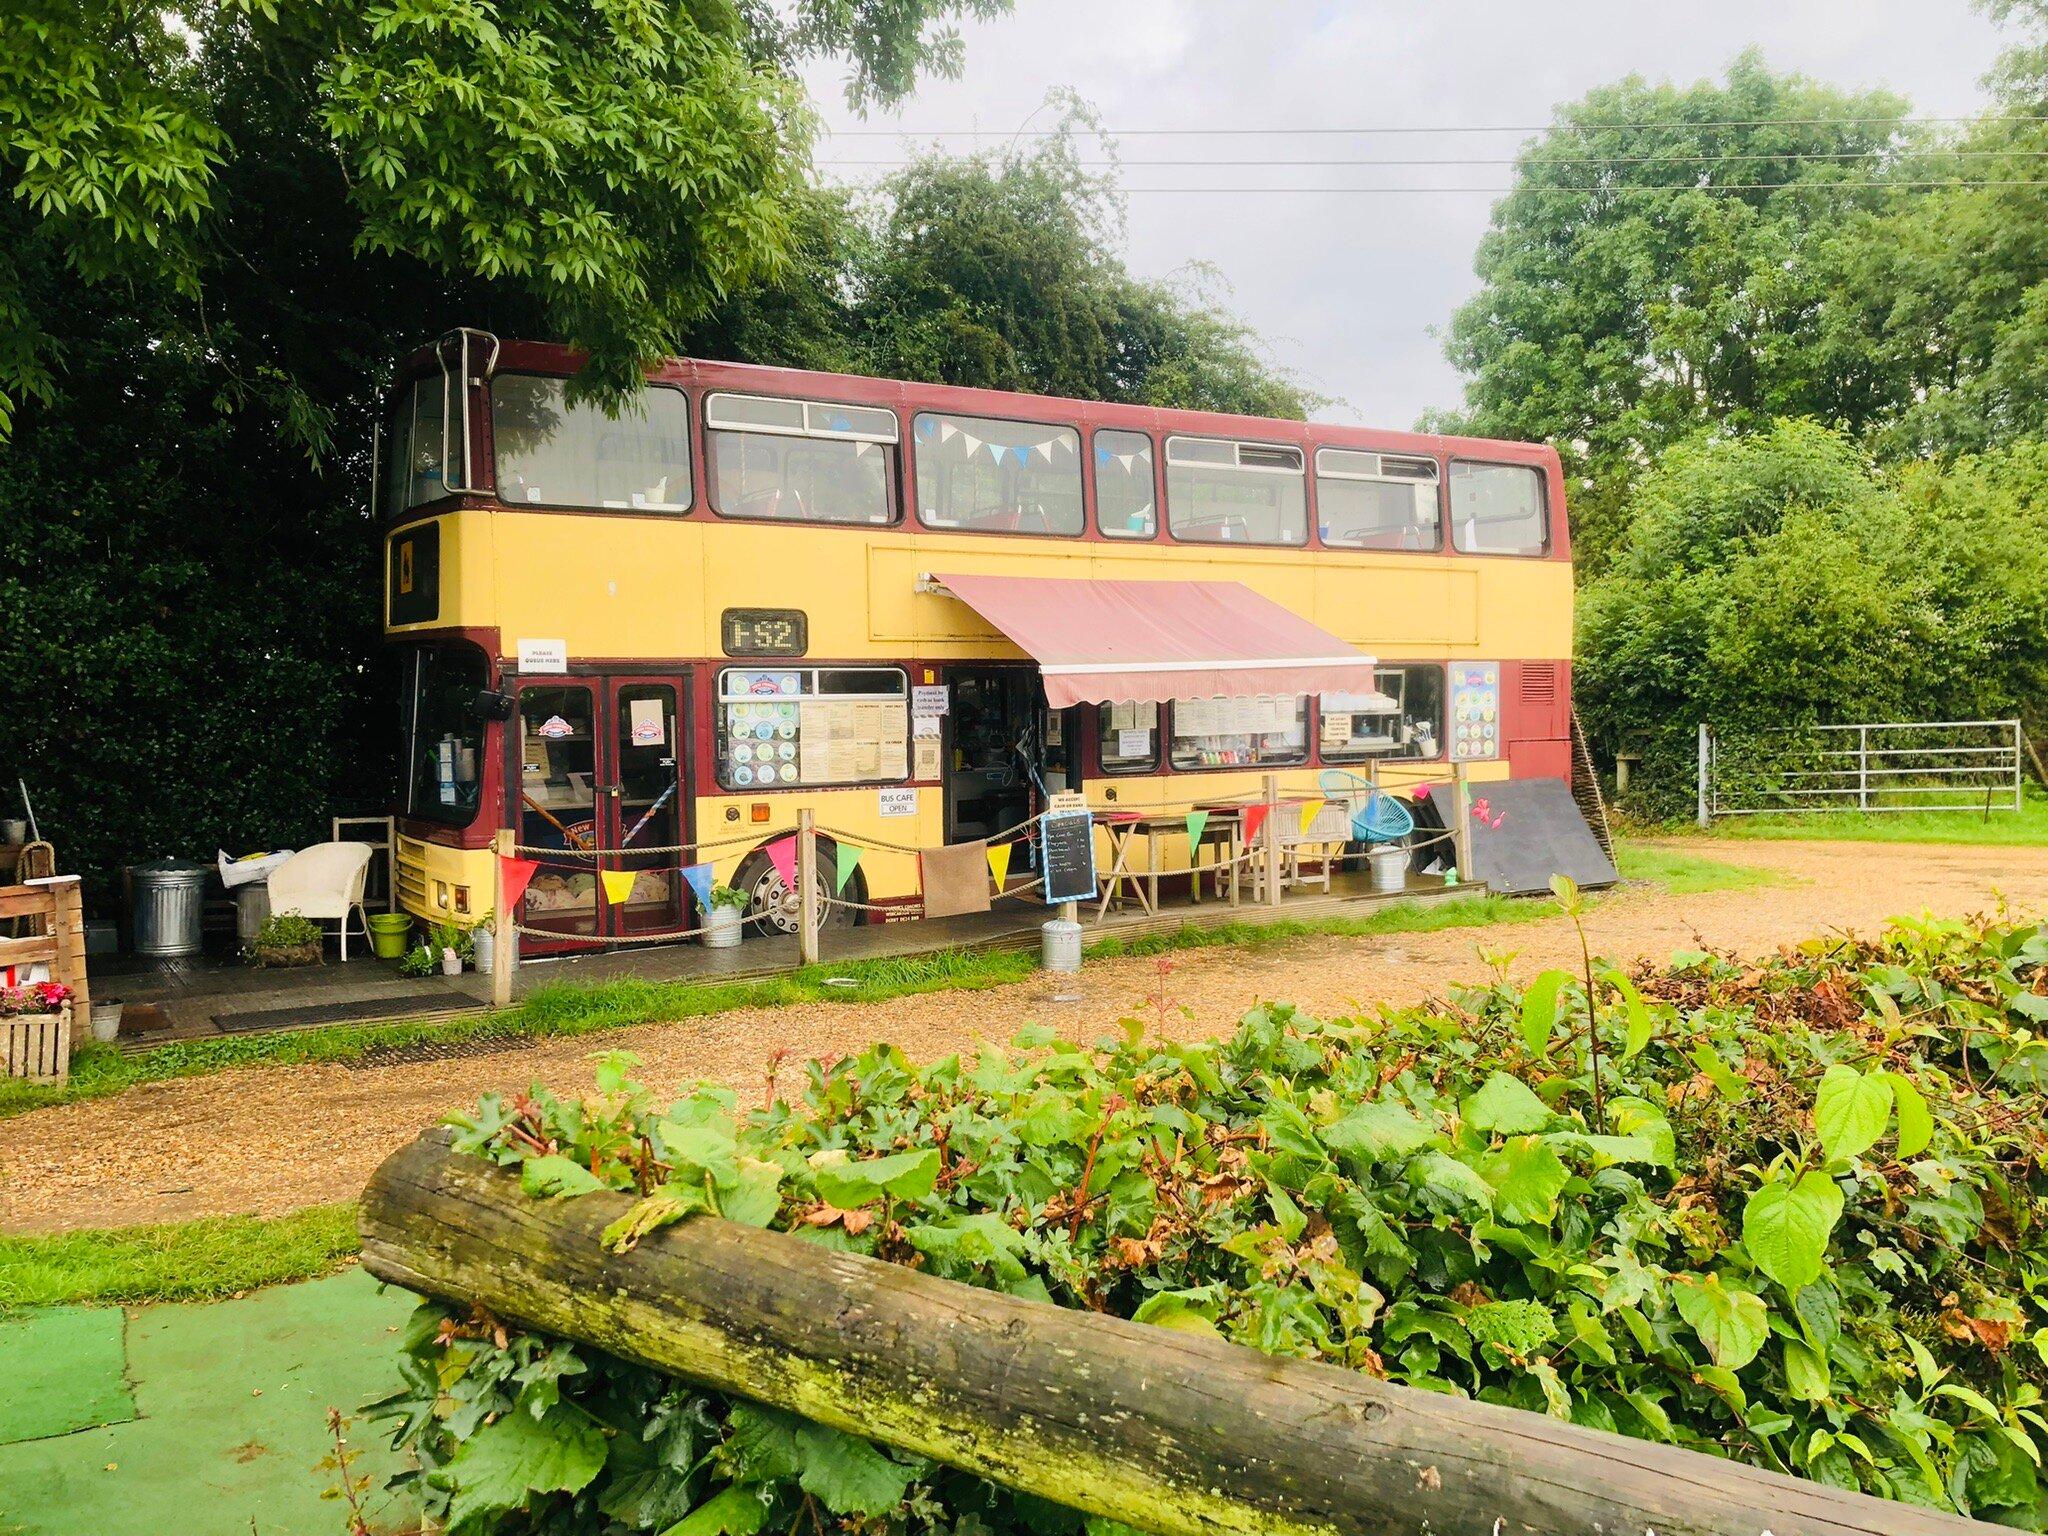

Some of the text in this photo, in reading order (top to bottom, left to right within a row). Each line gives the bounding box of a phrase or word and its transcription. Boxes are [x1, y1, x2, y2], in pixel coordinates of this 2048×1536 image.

[881, 793, 914, 803] BUS CAFE
[570, 823, 590, 834] New
